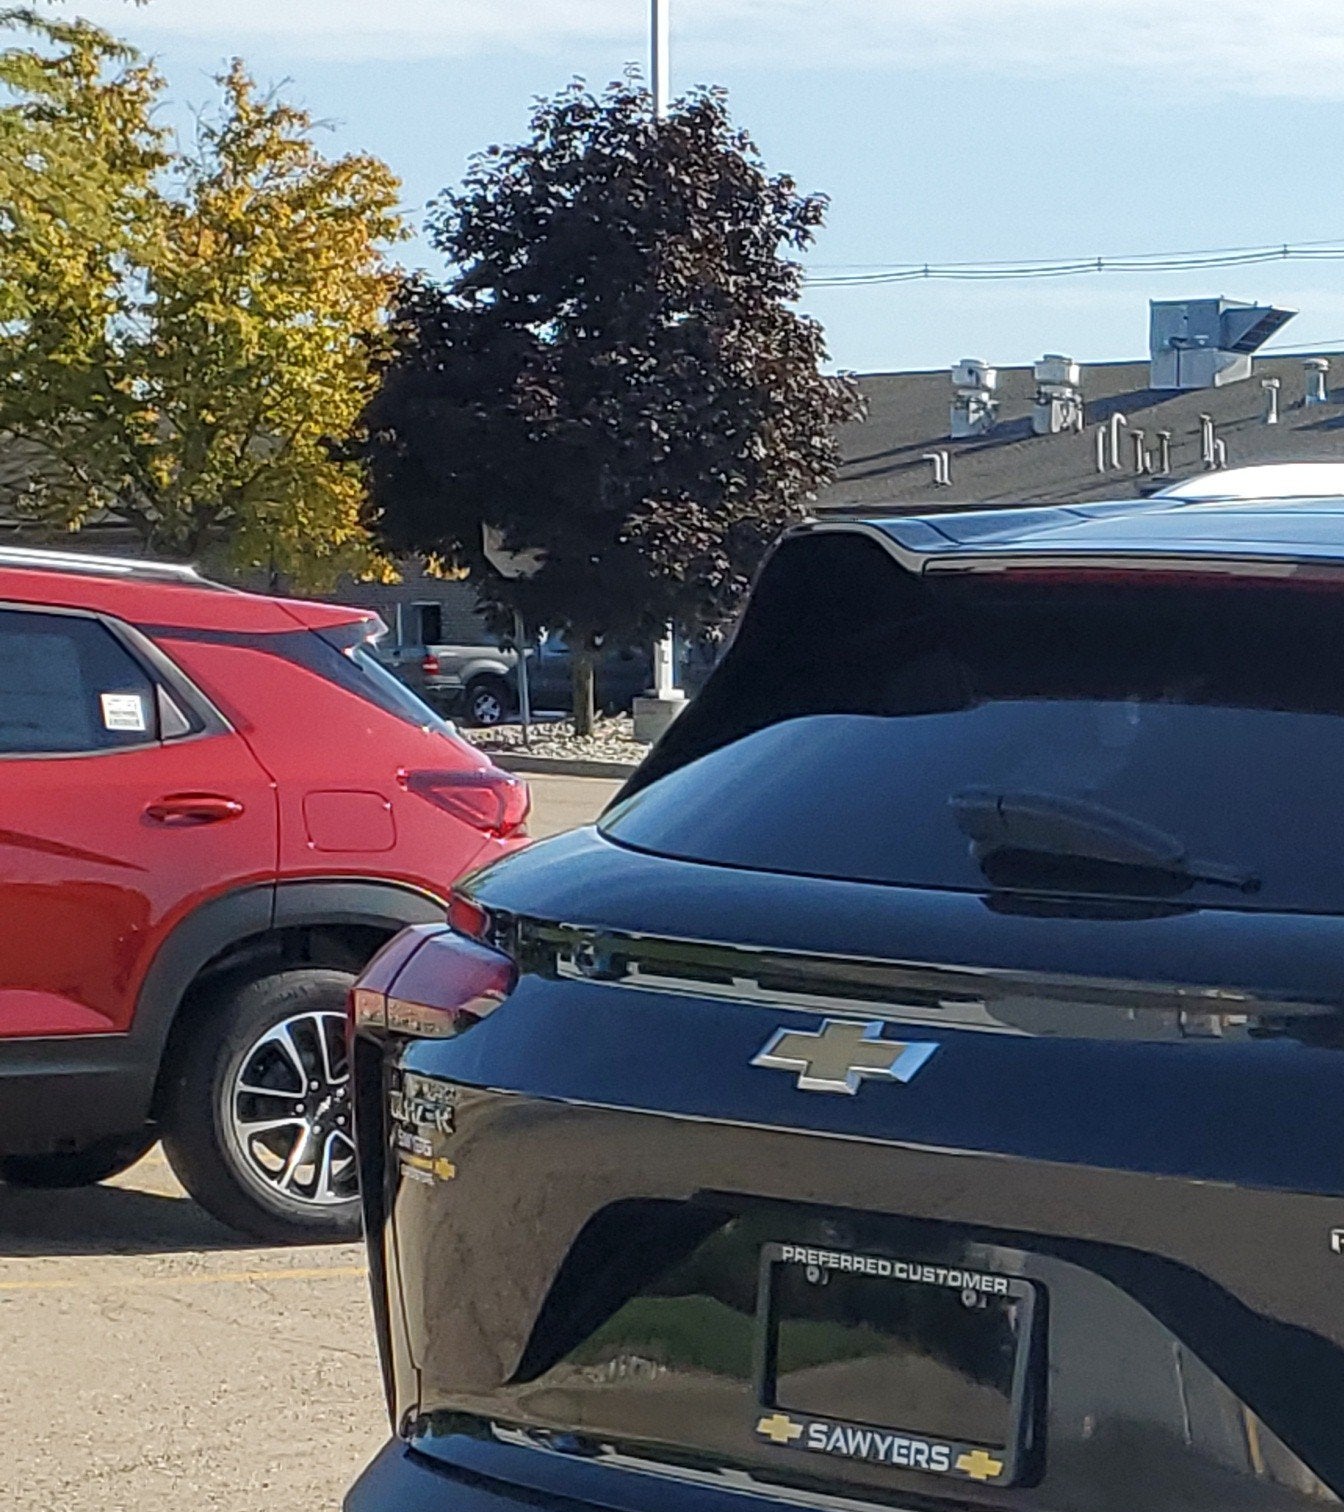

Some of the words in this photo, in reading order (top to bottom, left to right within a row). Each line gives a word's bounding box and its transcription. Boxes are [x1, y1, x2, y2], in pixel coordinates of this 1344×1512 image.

[781, 1245, 892, 1276] PREFERRED
[894, 1263, 1008, 1294] CUSTOMER
[807, 1423, 951, 1472] SAWYERS
